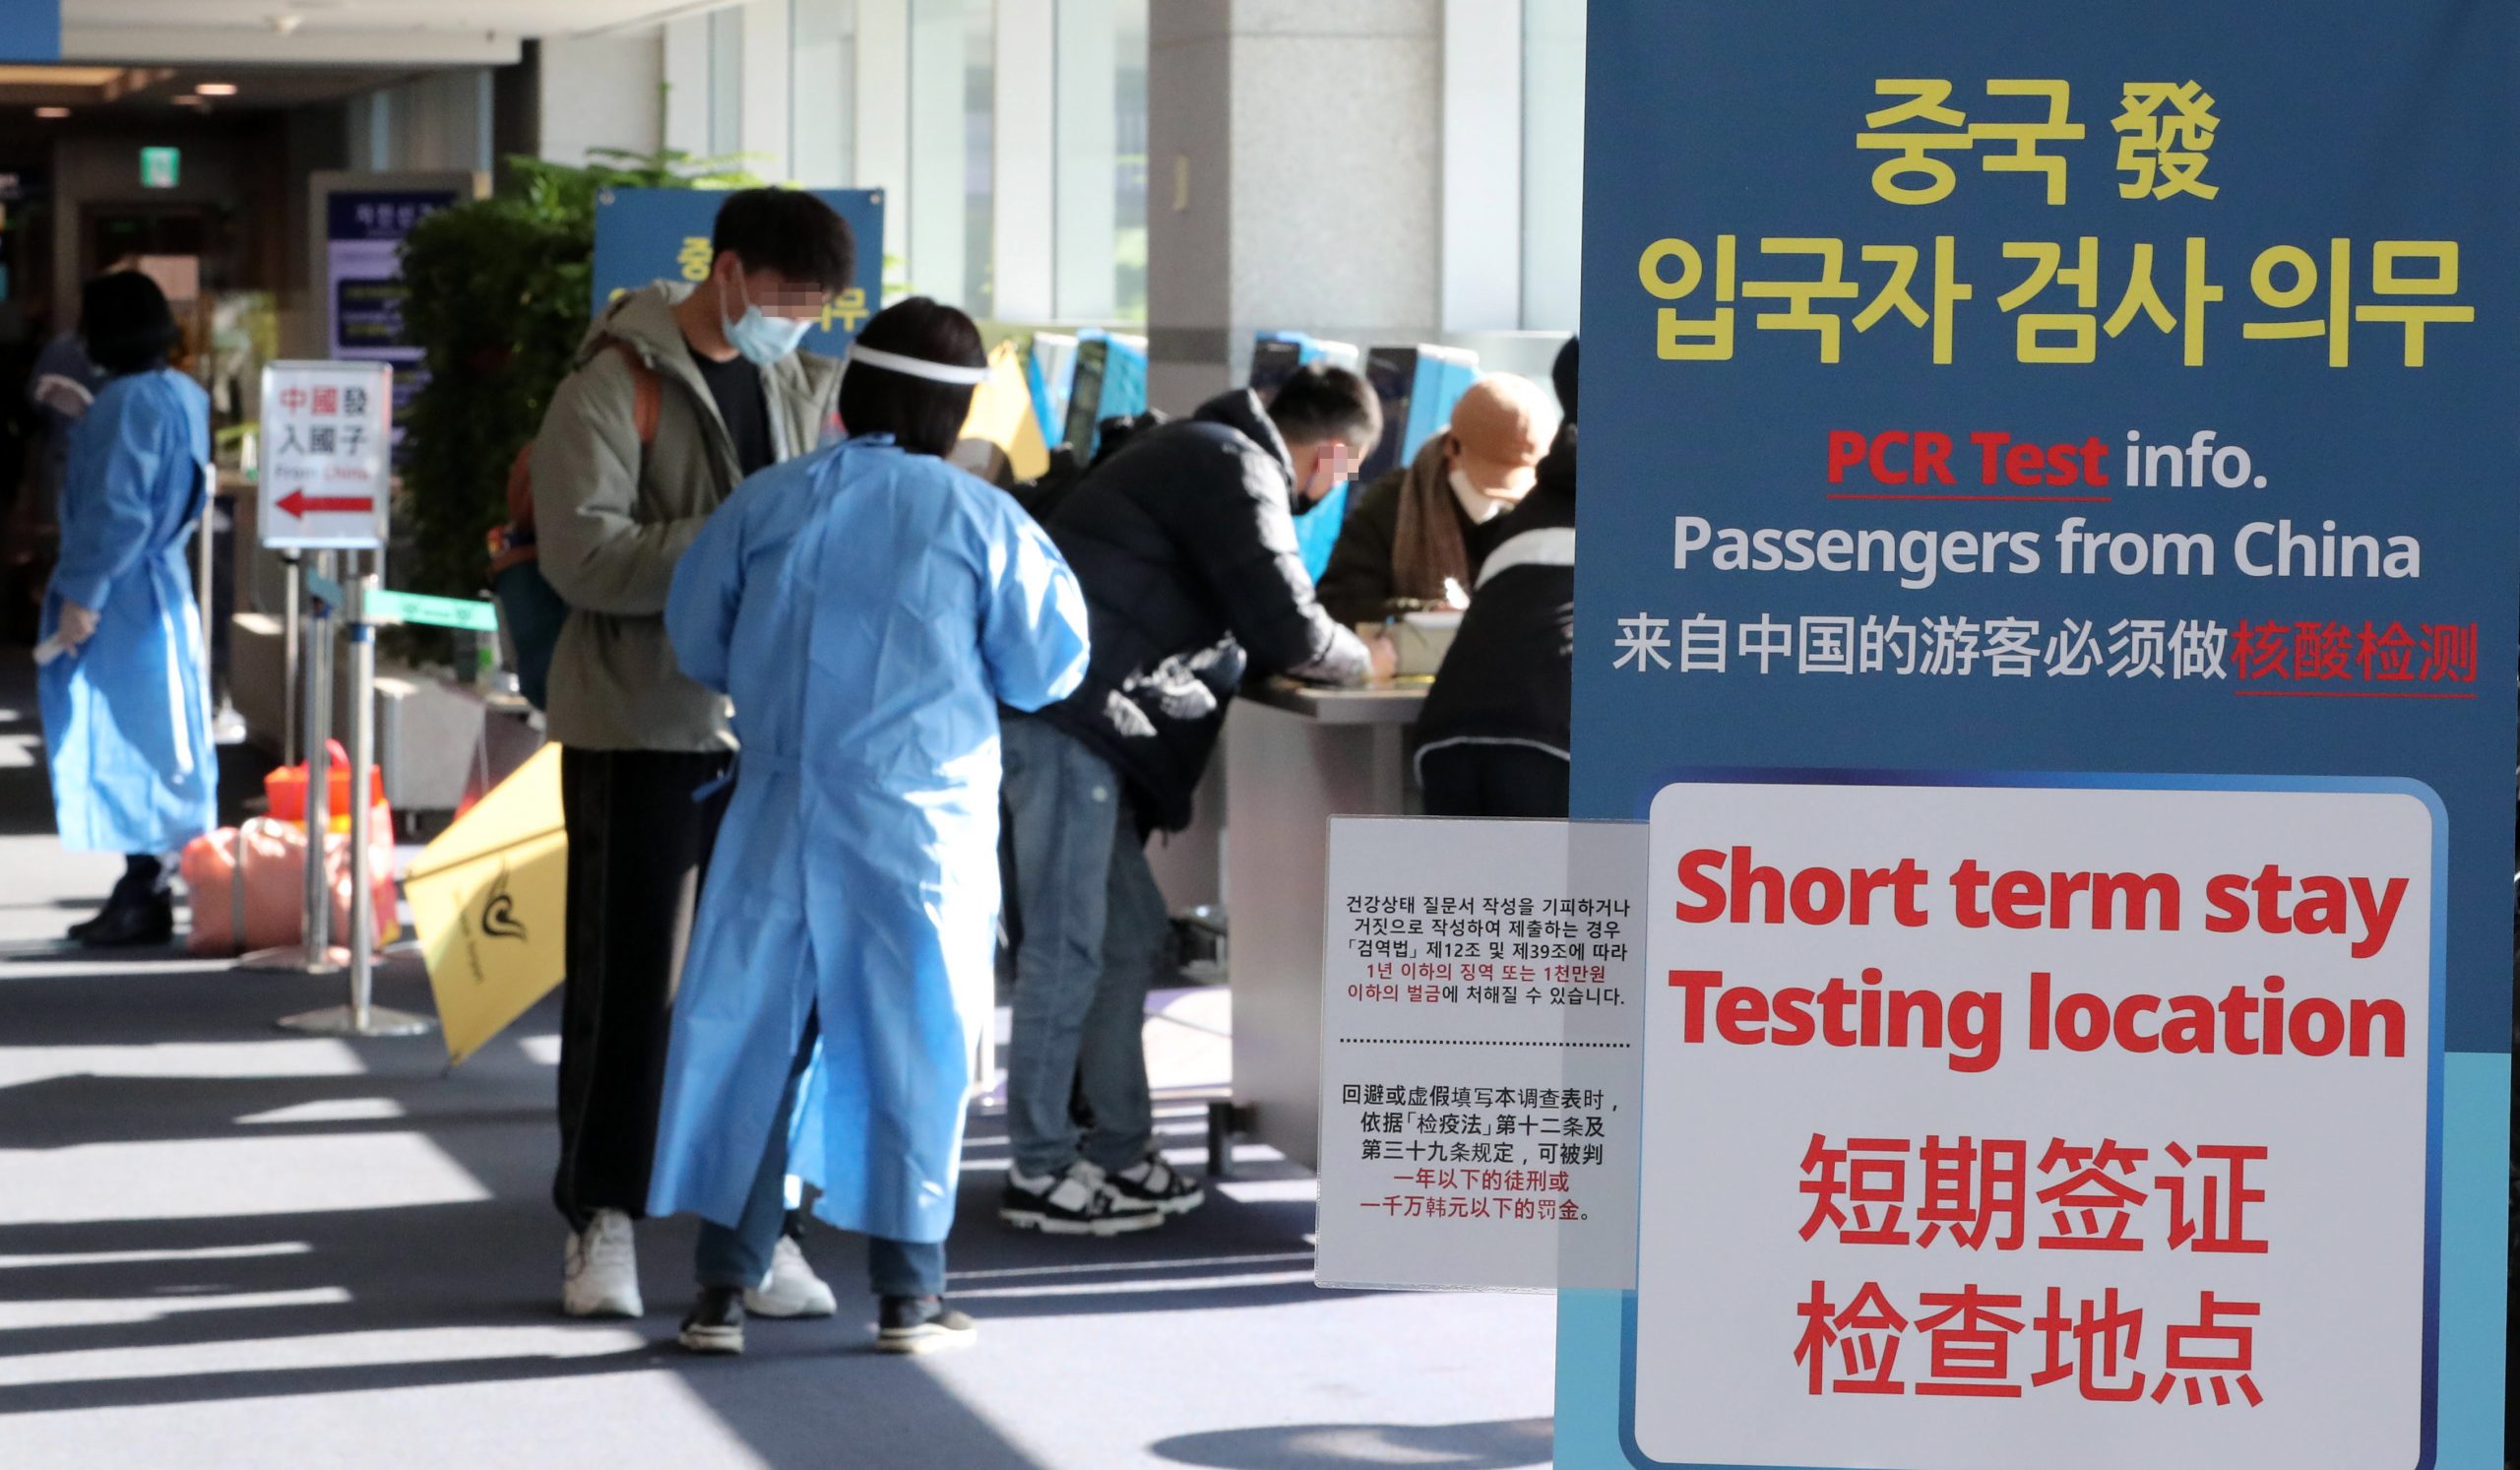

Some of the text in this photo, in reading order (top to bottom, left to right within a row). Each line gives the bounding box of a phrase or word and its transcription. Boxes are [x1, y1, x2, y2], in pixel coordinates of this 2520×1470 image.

[1857, 79, 2220, 205] 중국 發
[1639, 234, 2476, 367] 입국자 검사 의무
[280, 385, 367, 415] 中國發
[1828, 430, 2267, 488] PCR Test info.
[1674, 516, 2420, 589] Passengers from China
[1613, 612, 2477, 682] 来自中国的游客必须做核酸检测
[1348, 896, 1630, 917] 건강상태 질문서 작성을 기피하거나
[1676, 846, 2409, 959] Short term stay
[1350, 939, 1627, 961] 「검역법」 제12조 및 제39조에 따라
[1355, 918, 1619, 938] 거짓으로 작성하여 제출하는 경우
[1349, 985, 1624, 1005] 이하의 벌금에 처해질 수 있습니다.
[1368, 963, 1604, 983] 1년 이하의 징역 또는 1천만원
[1669, 968, 2405, 1072] Testing location
[1360, 1112, 1605, 1137] 依据「检疫法」第十二条及
[1394, 1168, 1569, 1192] 一年以下的徒刑或
[1798, 1133, 2268, 1253] 短期签证
[1360, 1195, 1590, 1220] 一千万韩元以下的罚金。
[1794, 1280, 2263, 1407] 检查地点
